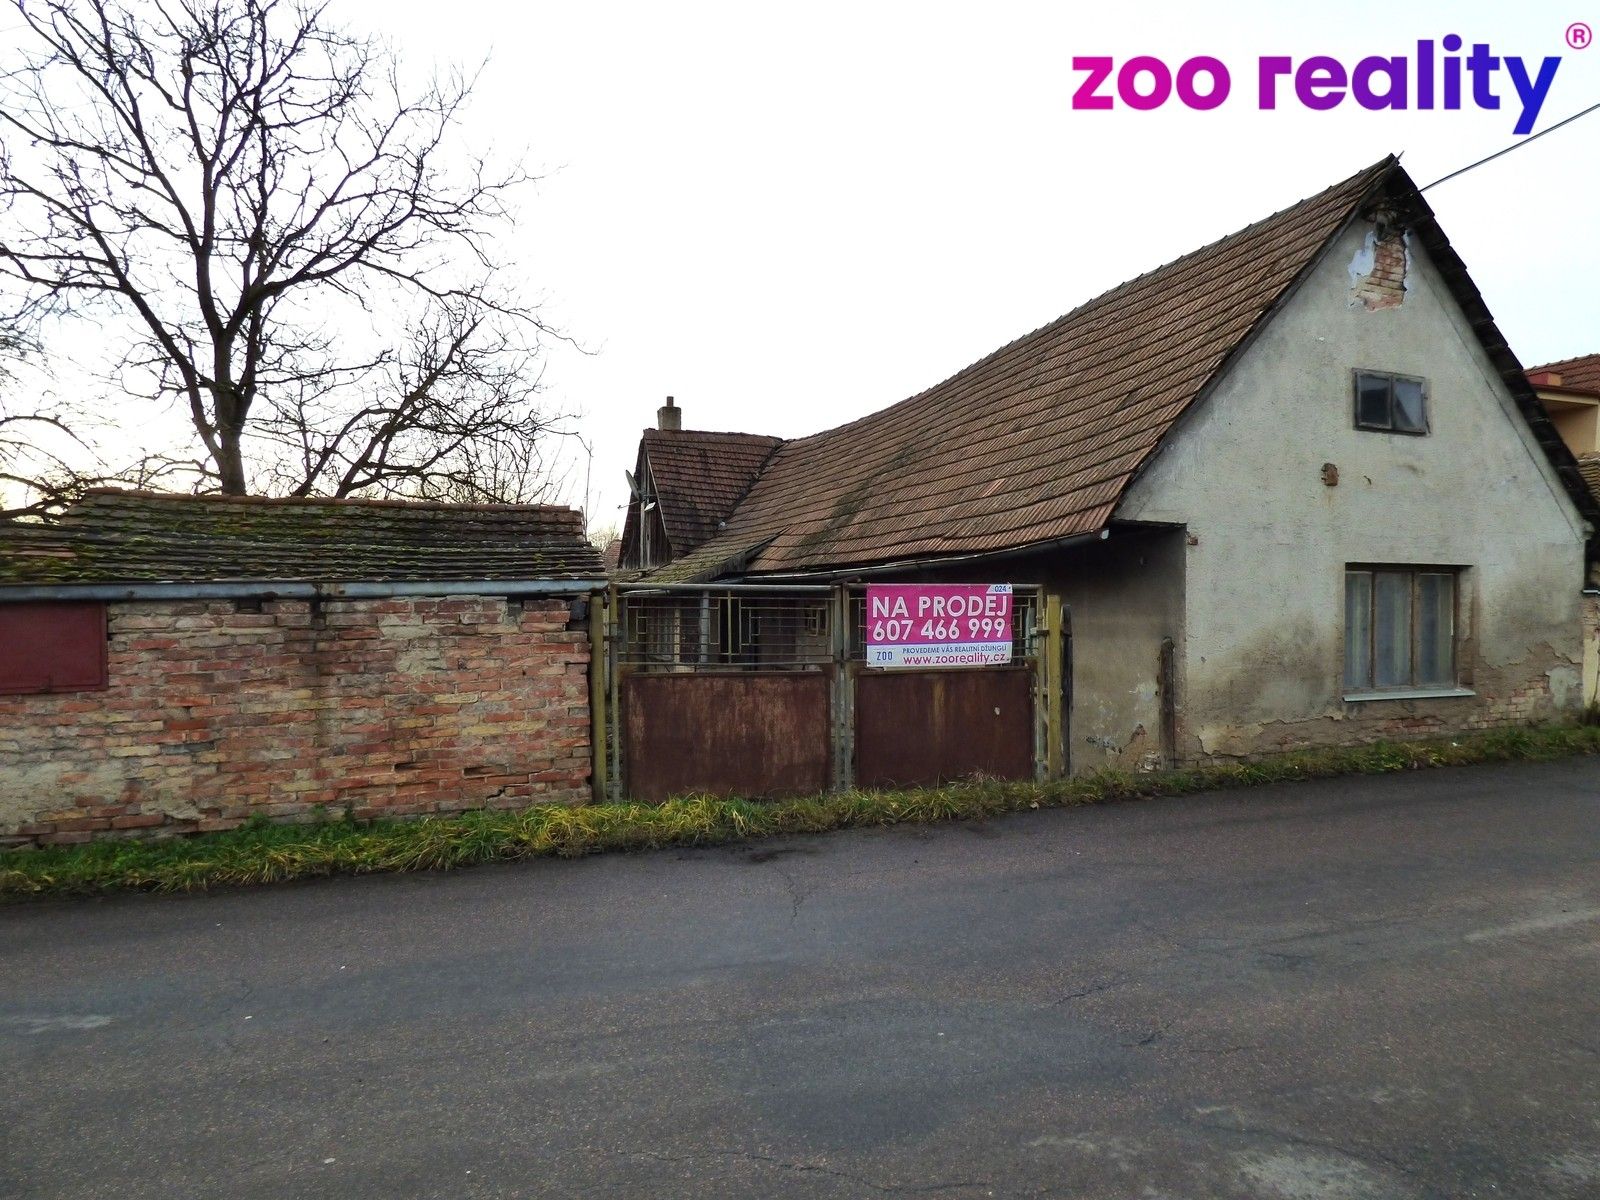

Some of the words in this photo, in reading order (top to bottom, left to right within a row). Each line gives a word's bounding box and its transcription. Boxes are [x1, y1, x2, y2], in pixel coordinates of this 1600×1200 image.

[872, 596, 909, 618] NA
[918, 595, 1007, 617] PRODEJ
[873, 619, 914, 641] 607
[920, 619, 960, 640] 466
[968, 618, 1006, 638] 999
[941, 645, 953, 653] VÁS
[954, 645, 980, 653] REALITNÍ
[980, 643, 1007, 652] DŽUNGLÍ
[876, 651, 893, 661] ZOO
[902, 652, 1006, 665] www.zooreality.cz
